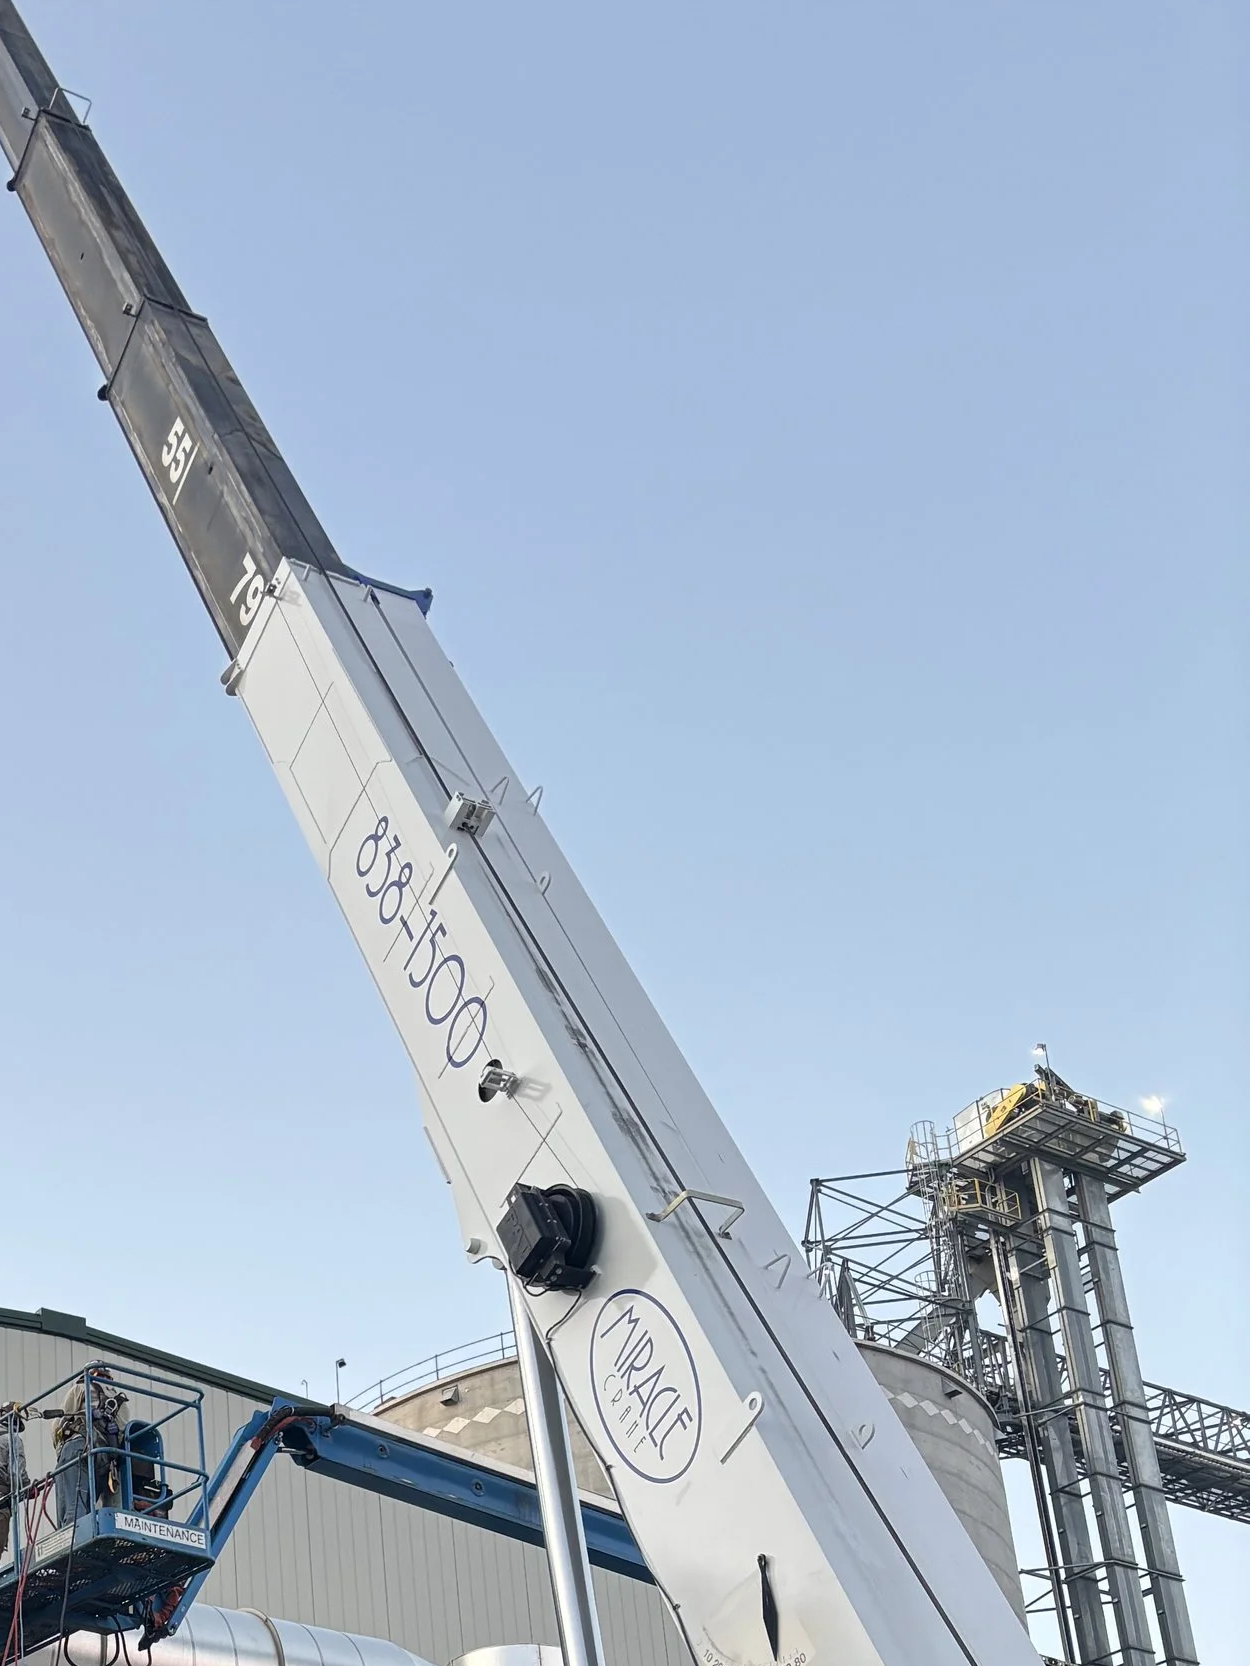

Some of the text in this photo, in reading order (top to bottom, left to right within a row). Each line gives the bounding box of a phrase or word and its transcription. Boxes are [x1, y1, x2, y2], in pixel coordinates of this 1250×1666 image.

[161, 416, 192, 484] 55
[230, 552, 264, 626] 79
[356, 815, 487, 1068] 838-1500
[600, 1305, 693, 1461] MIRACLE
[604, 1374, 646, 1453] CRANE
[124, 1516, 204, 1545] MAINTENANCE
[703, 1649, 714, 1662] 10
